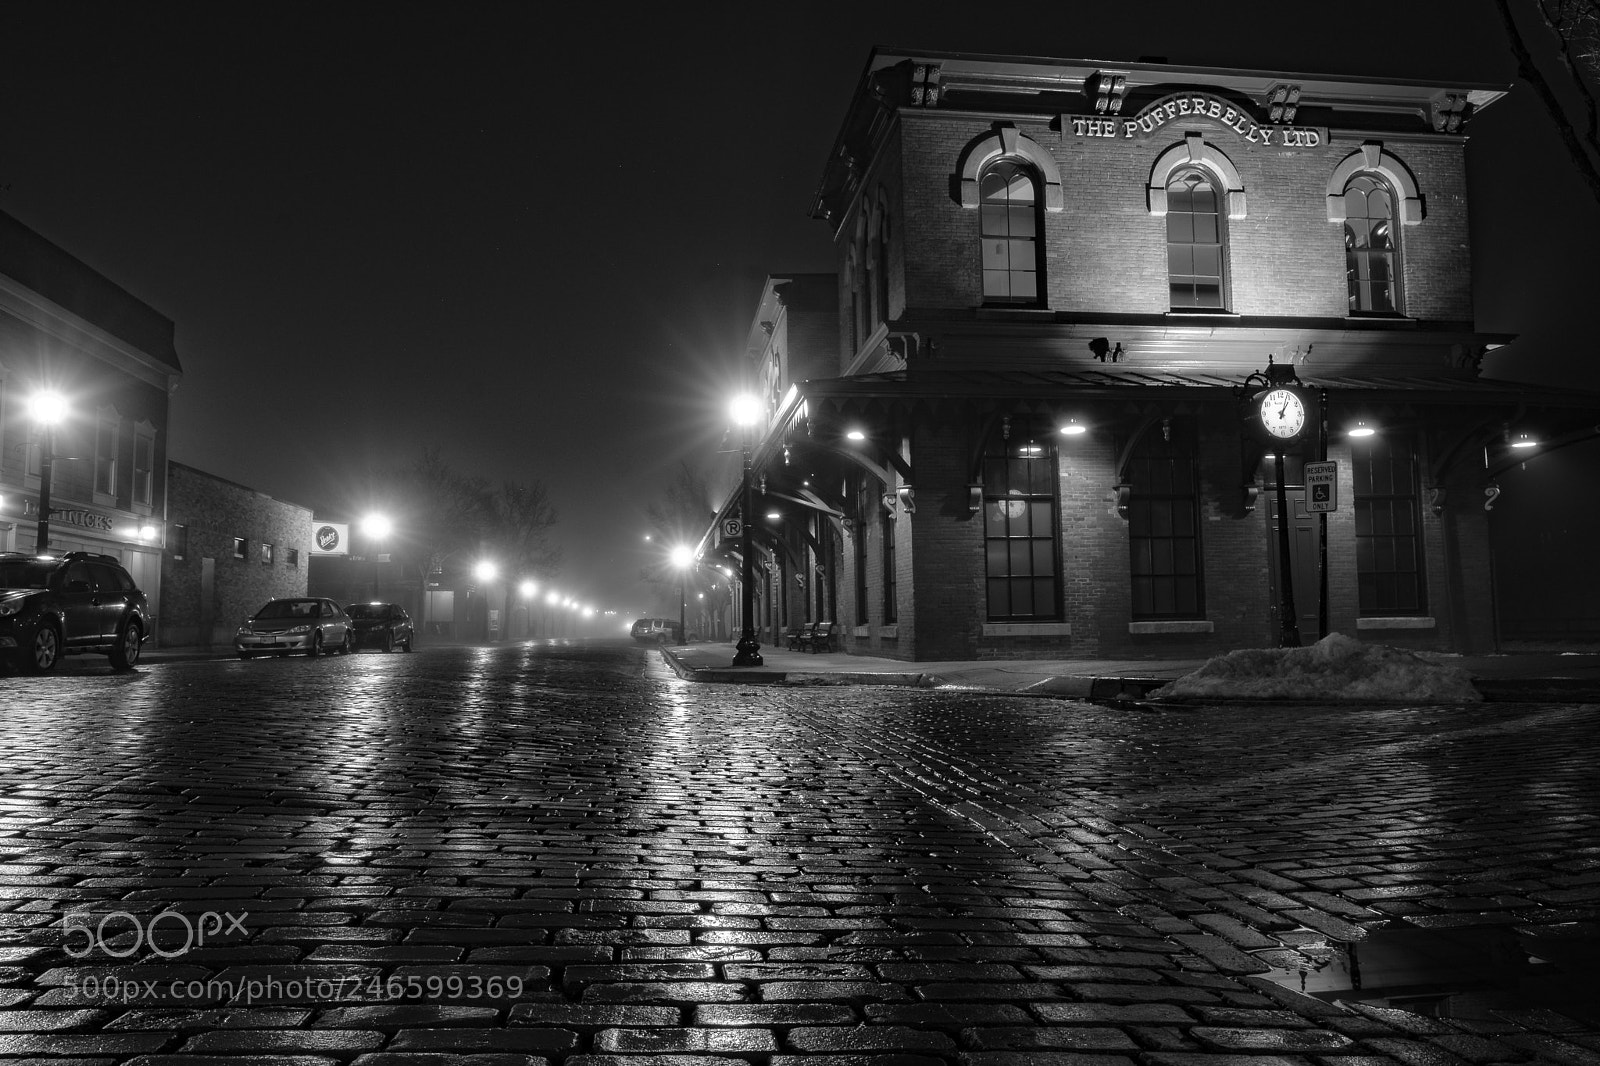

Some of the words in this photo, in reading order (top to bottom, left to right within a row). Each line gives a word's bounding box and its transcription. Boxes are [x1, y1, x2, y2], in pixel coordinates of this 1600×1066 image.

[1072, 118, 1116, 138] THE
[1123, 97, 1273, 146] PUFFERBELLY
[1282, 127, 1320, 147] LTD
[1307, 465, 1336, 475] RESERVED
[1308, 475, 1333, 483] PARKING
[1312, 502, 1329, 510] ONLY
[23, 499, 115, 532] DINICK'S
